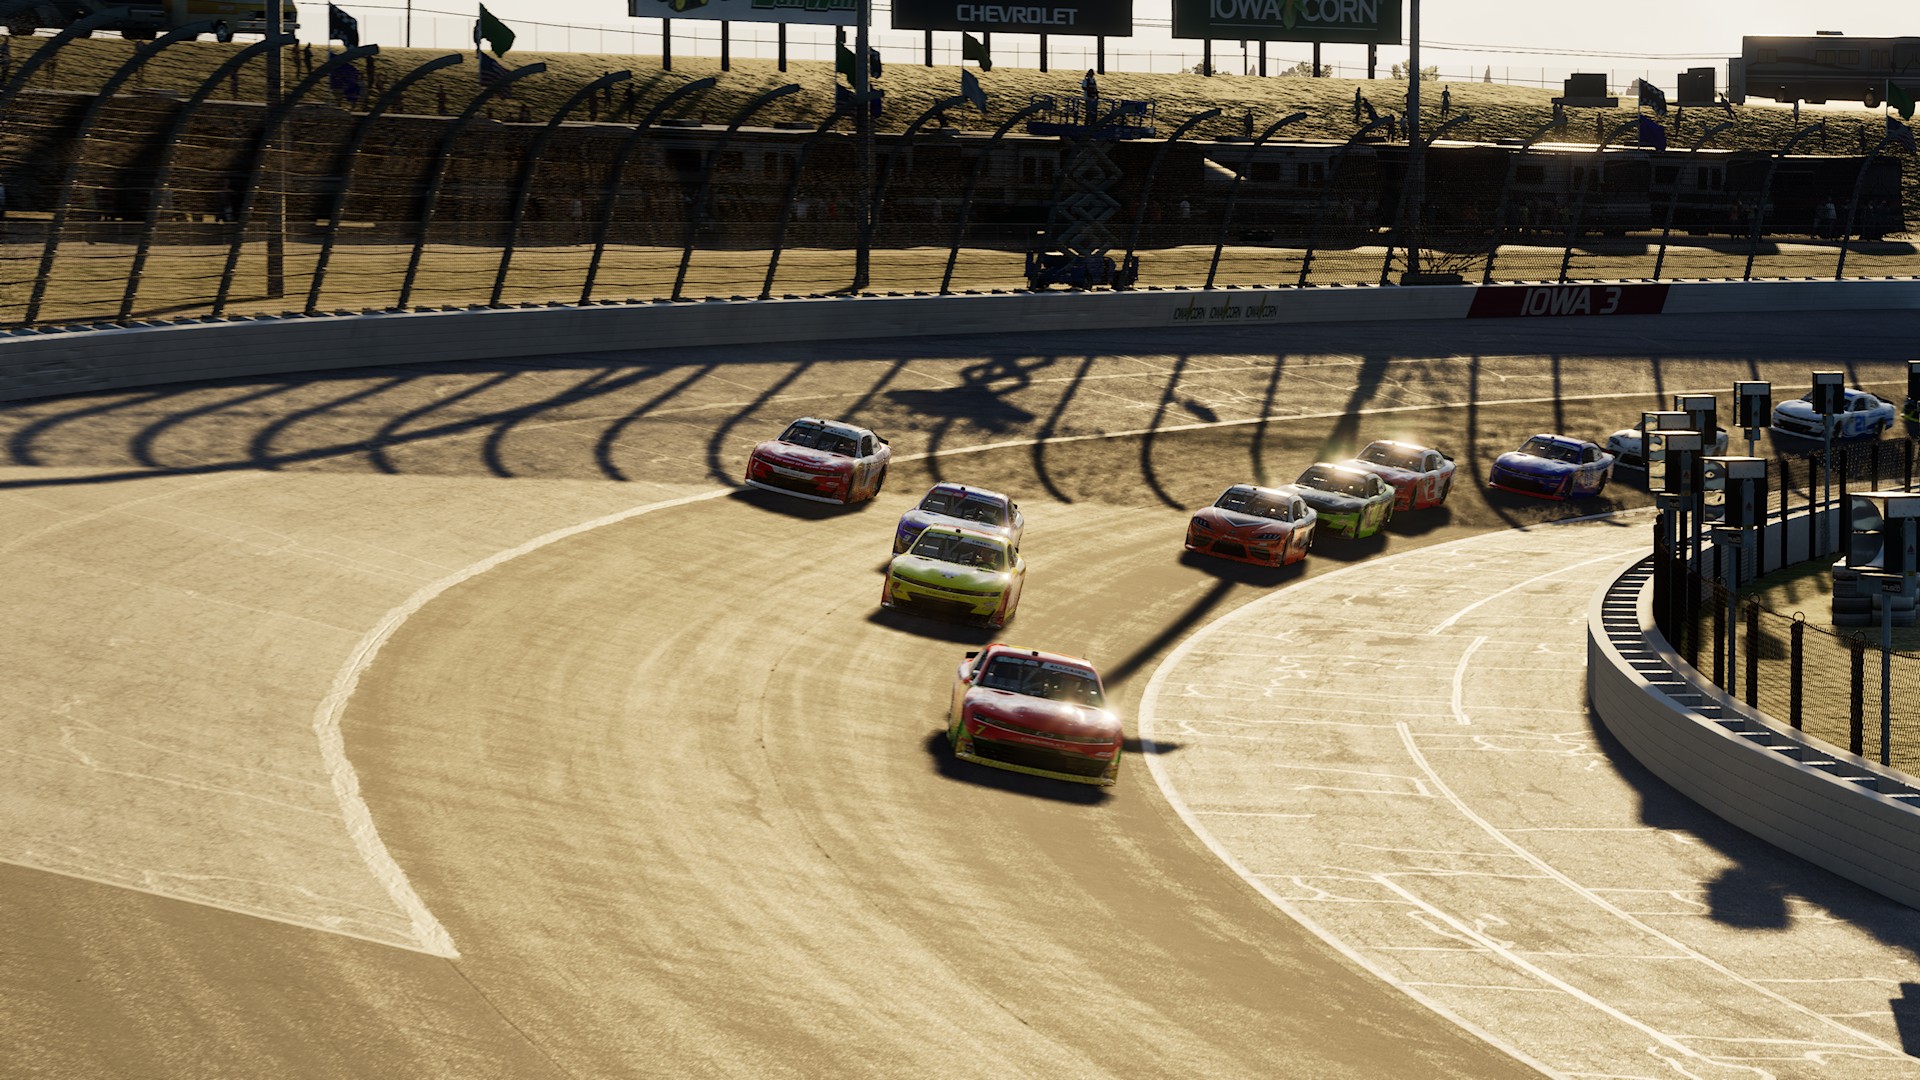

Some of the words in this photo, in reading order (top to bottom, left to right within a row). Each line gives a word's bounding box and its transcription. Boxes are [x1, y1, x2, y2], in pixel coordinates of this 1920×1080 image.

[956, 4, 1079, 25] CHEVROLET
[1209, 0, 1282, 20] IOWA
[1300, 0, 1378, 24] CORN
[1520, 287, 1591, 316] IOWA
[1599, 286, 1622, 314] 3
